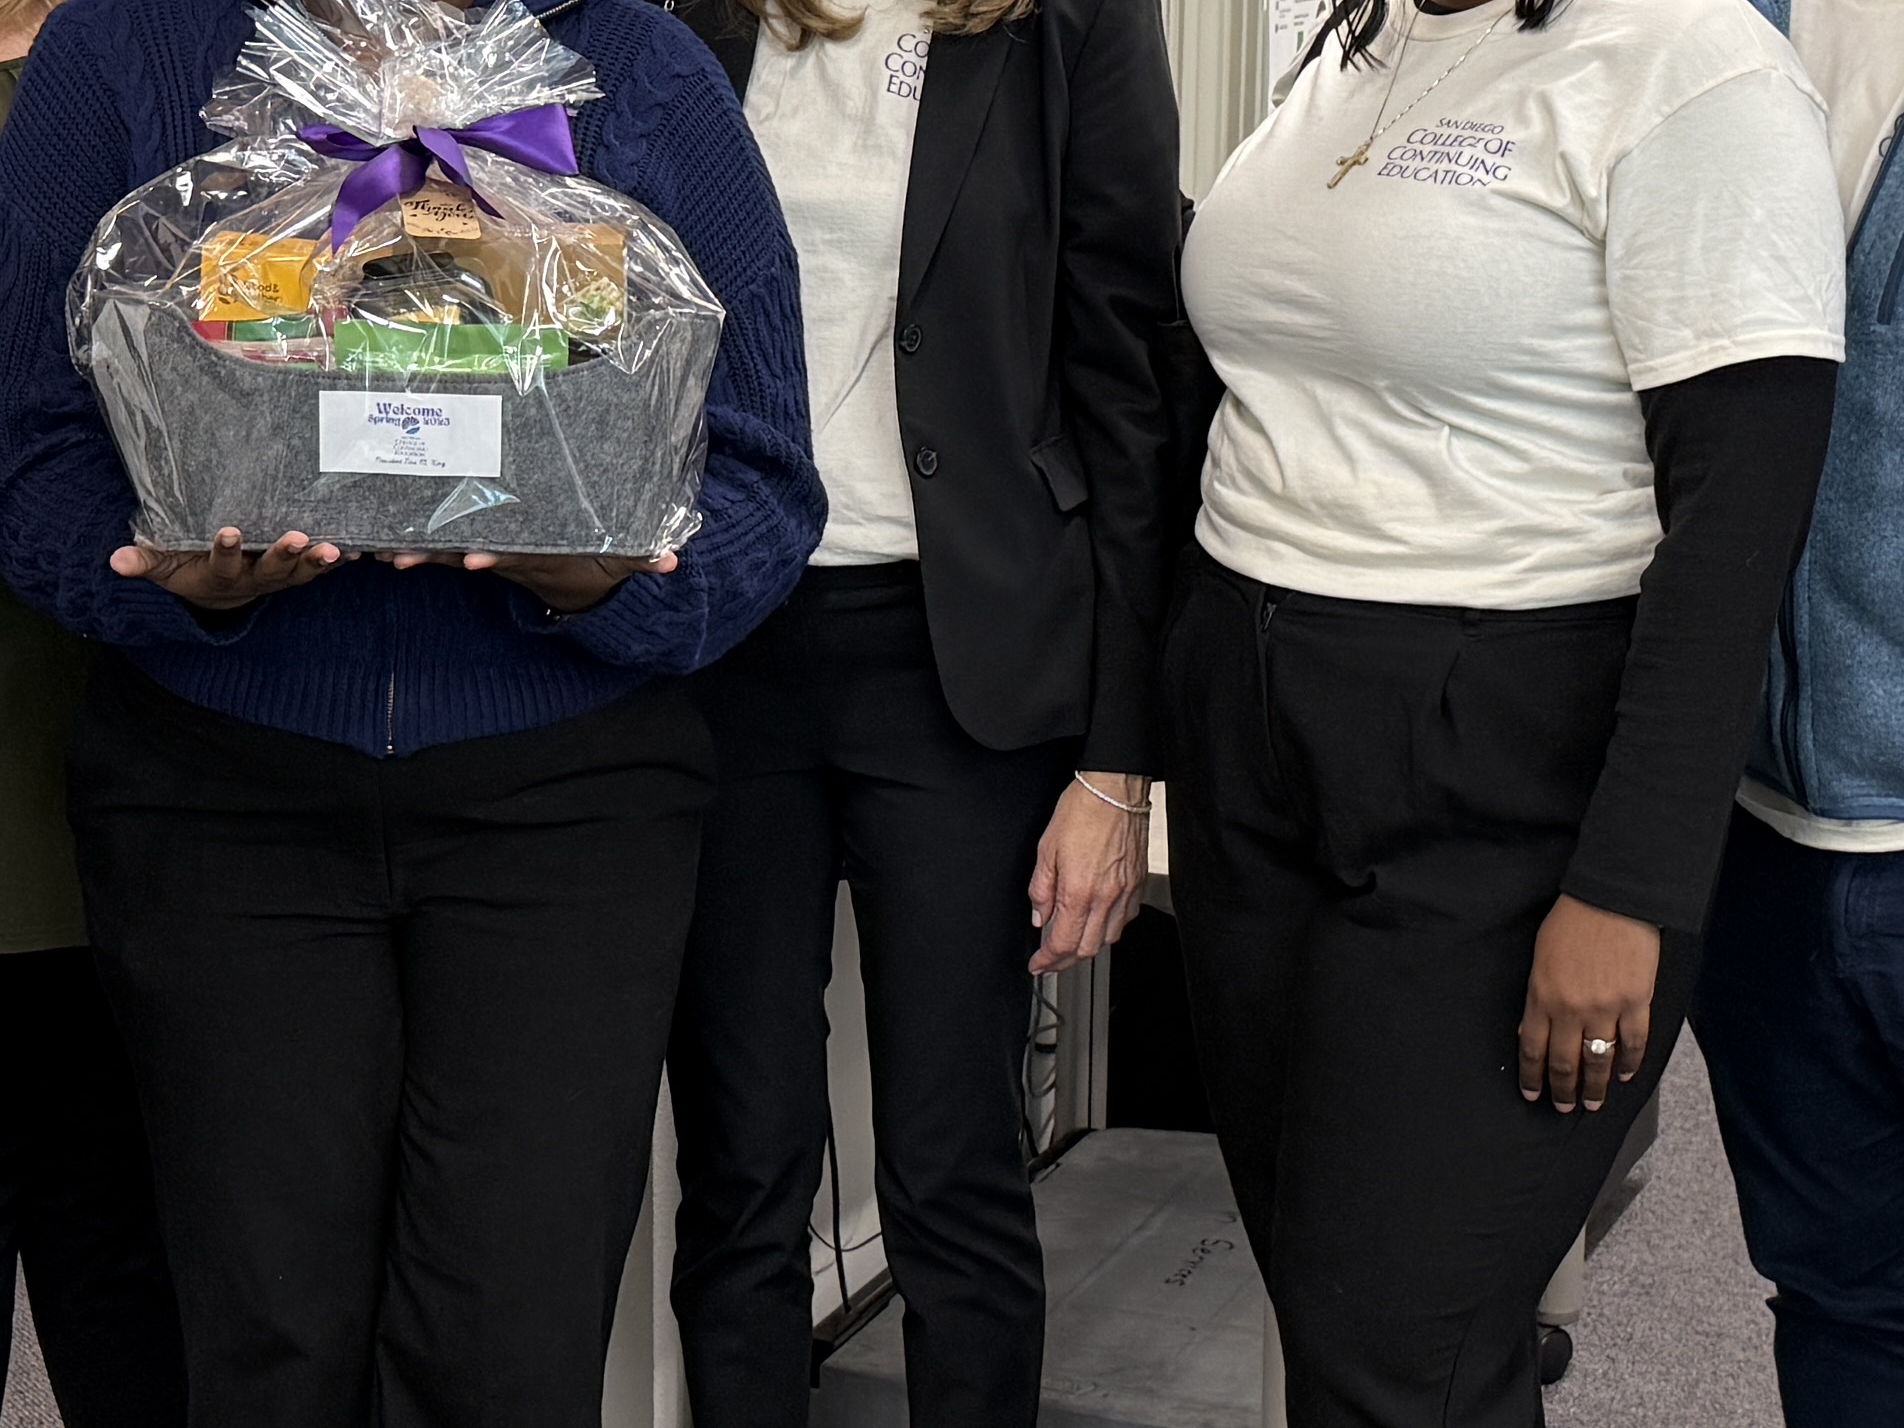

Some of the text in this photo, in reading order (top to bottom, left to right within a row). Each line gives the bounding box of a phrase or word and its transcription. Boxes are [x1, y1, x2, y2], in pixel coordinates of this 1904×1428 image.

[1436, 117, 1504, 135] SAN DIEGO
[1407, 128, 1516, 158] COLLEGE OF
[1387, 145, 1512, 182] CONTINUING
[1377, 162, 1491, 187] EDUCATION
[368, 413, 401, 427] Spring
[376, 402, 443, 417] Welcome
